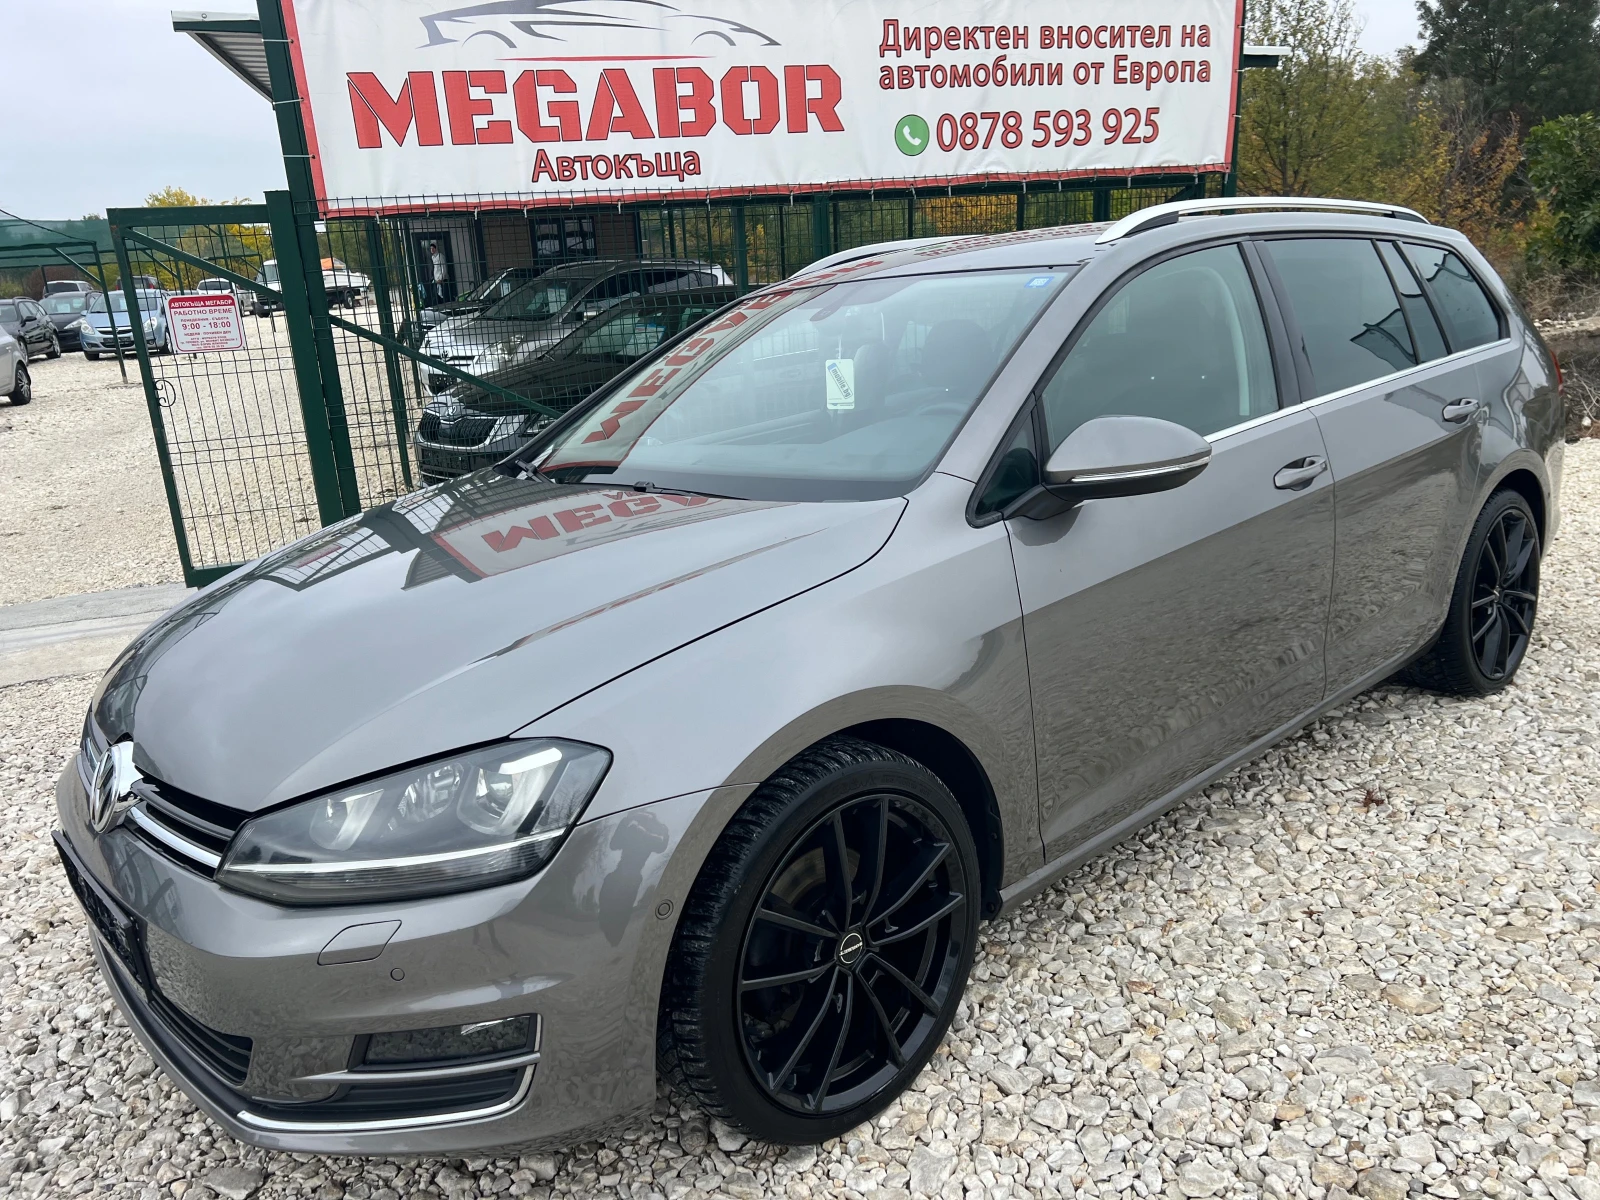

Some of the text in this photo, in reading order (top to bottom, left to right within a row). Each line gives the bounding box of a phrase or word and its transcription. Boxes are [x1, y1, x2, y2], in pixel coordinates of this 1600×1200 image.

[880, 19, 1211, 59] Директен вносител на
[879, 54, 1211, 91] автомобили от Европа
[346, 64, 845, 149] MEGABOR
[936, 107, 1161, 153] 0878 593 925
[531, 149, 702, 183] Автокъща
[831, 368, 851, 397] mobile.bg
